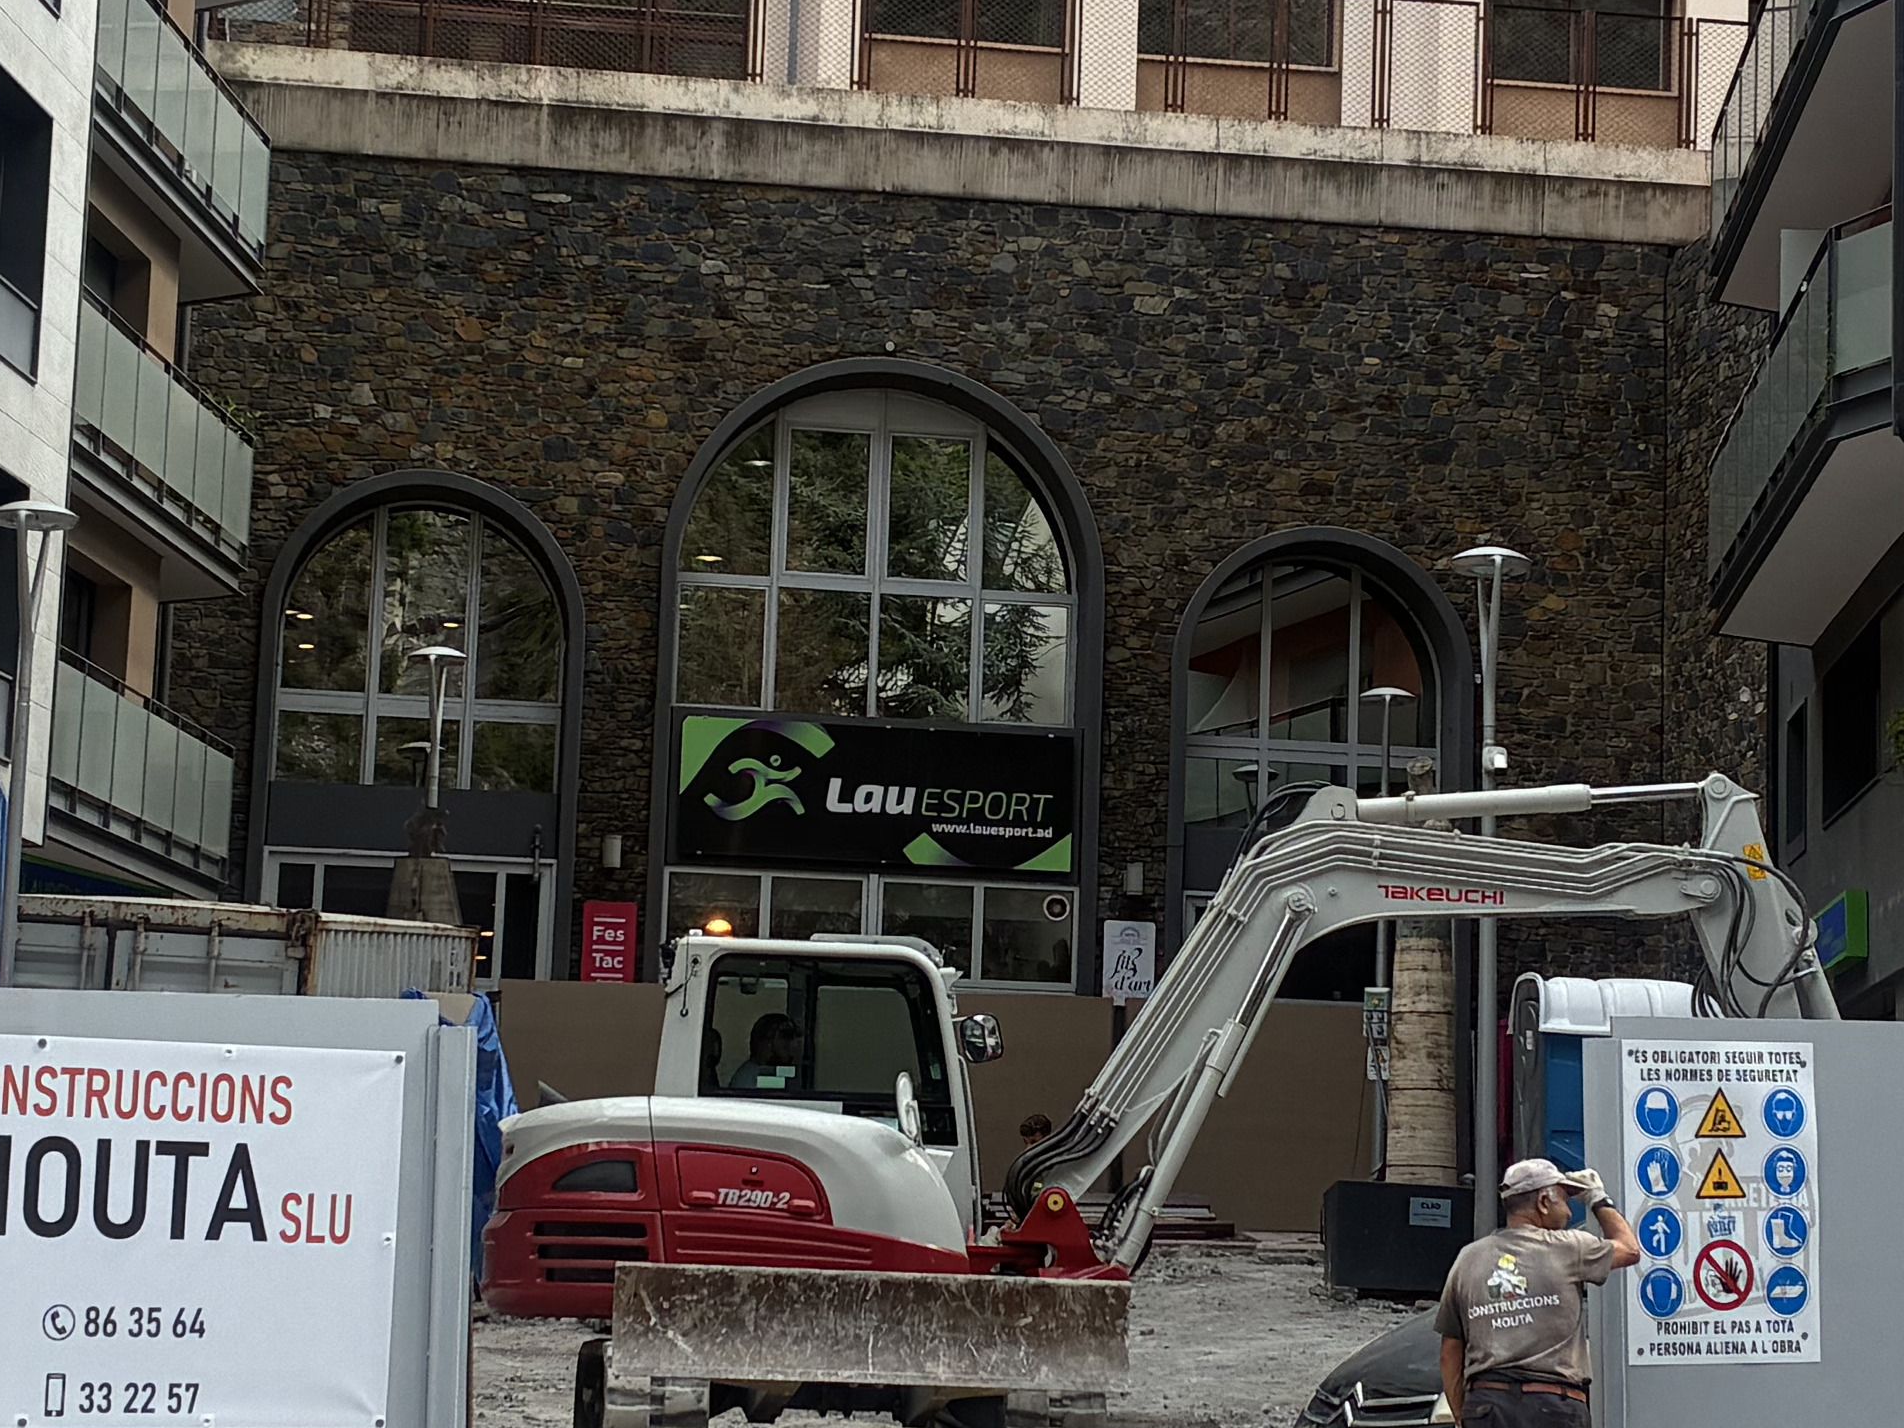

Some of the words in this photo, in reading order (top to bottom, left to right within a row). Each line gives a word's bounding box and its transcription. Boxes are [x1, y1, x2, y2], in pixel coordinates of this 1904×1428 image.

[826, 777, 917, 815] Lau
[921, 789, 1053, 823] ESPORT
[931, 821, 1053, 839] www.lauesport.ad
[1377, 884, 1504, 905] TAKEUCHI
[592, 926, 625, 942] Fes
[591, 953, 624, 969] Tac
[1652, 1050, 1721, 1064] OBLIGATORI
[1724, 1051, 1764, 1065] SEGUIR
[1640, 1068, 1661, 1082] LES
[1665, 1068, 1713, 1082] NORMES
[1717, 1069, 1732, 1082] DE
[1735, 1069, 1798, 1083] SEGURETAT
[716, 1188, 791, 1209] TB290-2
[279, 1193, 352, 1245] SLU
[1467, 1294, 1560, 1320] CONSTRUCCIONS
[84, 1306, 117, 1338] 86
[128, 1307, 162, 1338] 35
[172, 1307, 206, 1339] 64
[1491, 1313, 1534, 1330] MOUTA
[1656, 1320, 1710, 1336] PROHIBIT
[1713, 1321, 1727, 1335] EL
[1731, 1320, 1752, 1334] PAS
[1755, 1320, 1763, 1334] A
[1766, 1319, 1795, 1334] TOTA
[1649, 1341, 1702, 1356] PERSONA
[1705, 1341, 1747, 1355] ALIENA
[1750, 1340, 1758, 1354] A
[79, 1383, 112, 1414] 33
[123, 1383, 157, 1414] 22
[167, 1383, 200, 1415] 57
